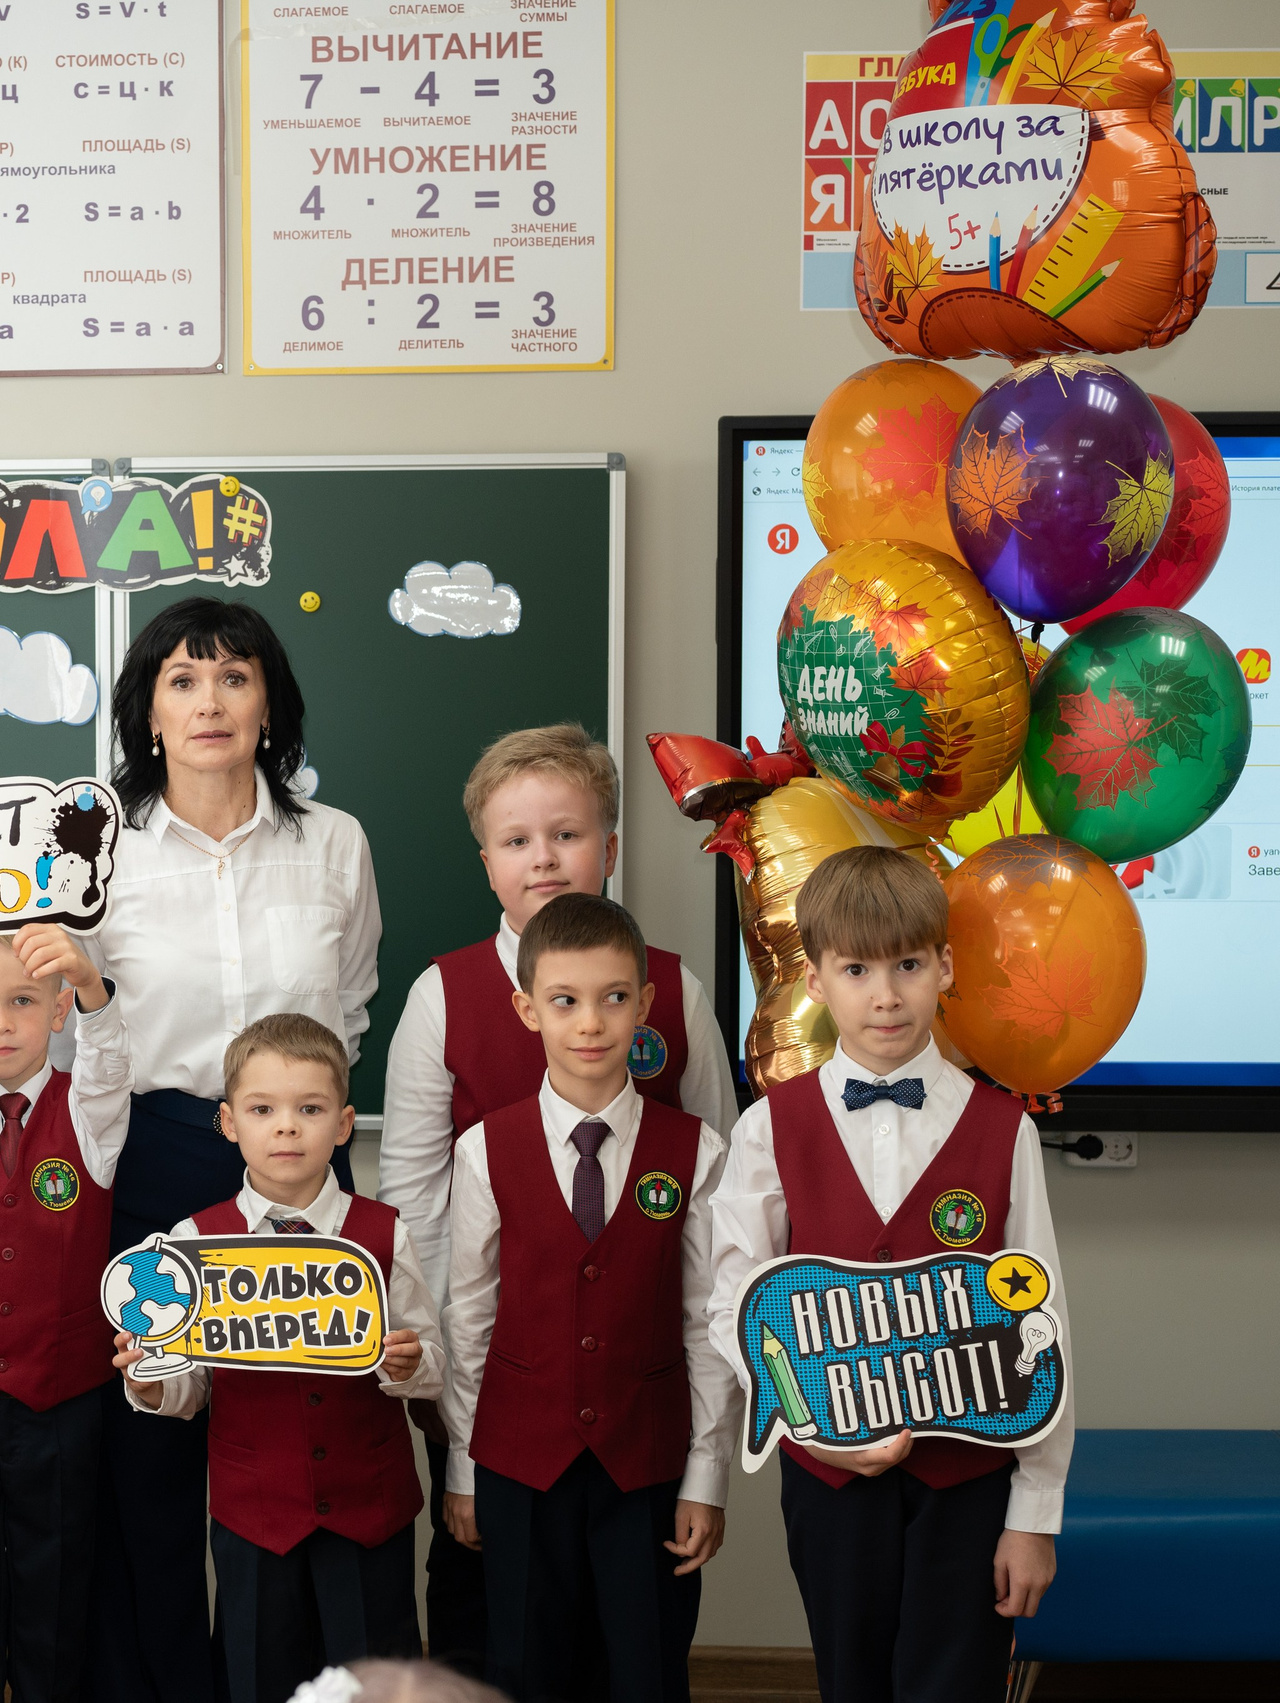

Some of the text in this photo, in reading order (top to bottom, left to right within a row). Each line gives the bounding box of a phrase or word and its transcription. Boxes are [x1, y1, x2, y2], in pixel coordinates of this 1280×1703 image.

[273, 6, 349, 18] СЛАГАЕМОЕ
[389, 4, 465, 16] СЛАГАЕМОЕ
[510, 0, 577, 9] ЗНАЧЕНИЕ
[519, 12, 568, 23] СУММЫ
[310, 31, 544, 63] ВЫЧИТАНИЕ
[55, 53, 159, 68] СТОИМОСТЬ
[299, 69, 556, 110] 7 4 3
[262, 118, 362, 130] УМЕНЬШАЕМОЕ
[383, 115, 472, 128] ВЫЧИТАЕМОЕ
[511, 111, 578, 123] ЗНАЧЕНИЕ
[809, 99, 849, 150] А
[1200, 96, 1243, 147] Л
[511, 124, 578, 136] РАЗНОСТИ
[899, 117, 1005, 155] школу
[1016, 115, 1065, 138] за
[82, 138, 191, 154] ПЛОЩАДЬ (S)
[309, 143, 547, 176] УМНОЖЕНИЕ
[878, 158, 1063, 205] пятёрками
[299, 180, 556, 221] 4 2 8
[809, 174, 846, 225] Я
[273, 229, 353, 241] МНОЖИТЕЛЬ
[391, 227, 471, 239] МНОЖИТЕЛЬ
[510, 223, 577, 234] ЗНАЧЕНИЕ
[948, 212, 982, 251] 5+
[493, 236, 595, 249] ПРОИЗВЕДЕНИЯ
[83, 269, 192, 285] ПЛОЩАДЬ (S)
[341, 256, 515, 291] ДЕЛЕНИЕ
[12, 293, 87, 308] квадрата
[301, 291, 556, 331] 6 2 3
[511, 328, 578, 340] ЗНАЧЕНИЕ
[282, 341, 344, 353] ДЕЛИМОЕ
[398, 339, 465, 352] ДЕЛИТЕЛЬ
[511, 342, 578, 353] ЧАСТНОГО
[770, 447, 794, 455] Яндекс
[796, 663, 863, 707] ДЕНЬ
[797, 705, 869, 737] ЗНАНИЙ
[203, 1261, 363, 1305] ТОЛЬКО
[791, 1268, 972, 1355] НОВЫХ
[203, 1307, 373, 1353] ВПЕРЕД!
[826, 1340, 1009, 1435] ВЫСОТ!
